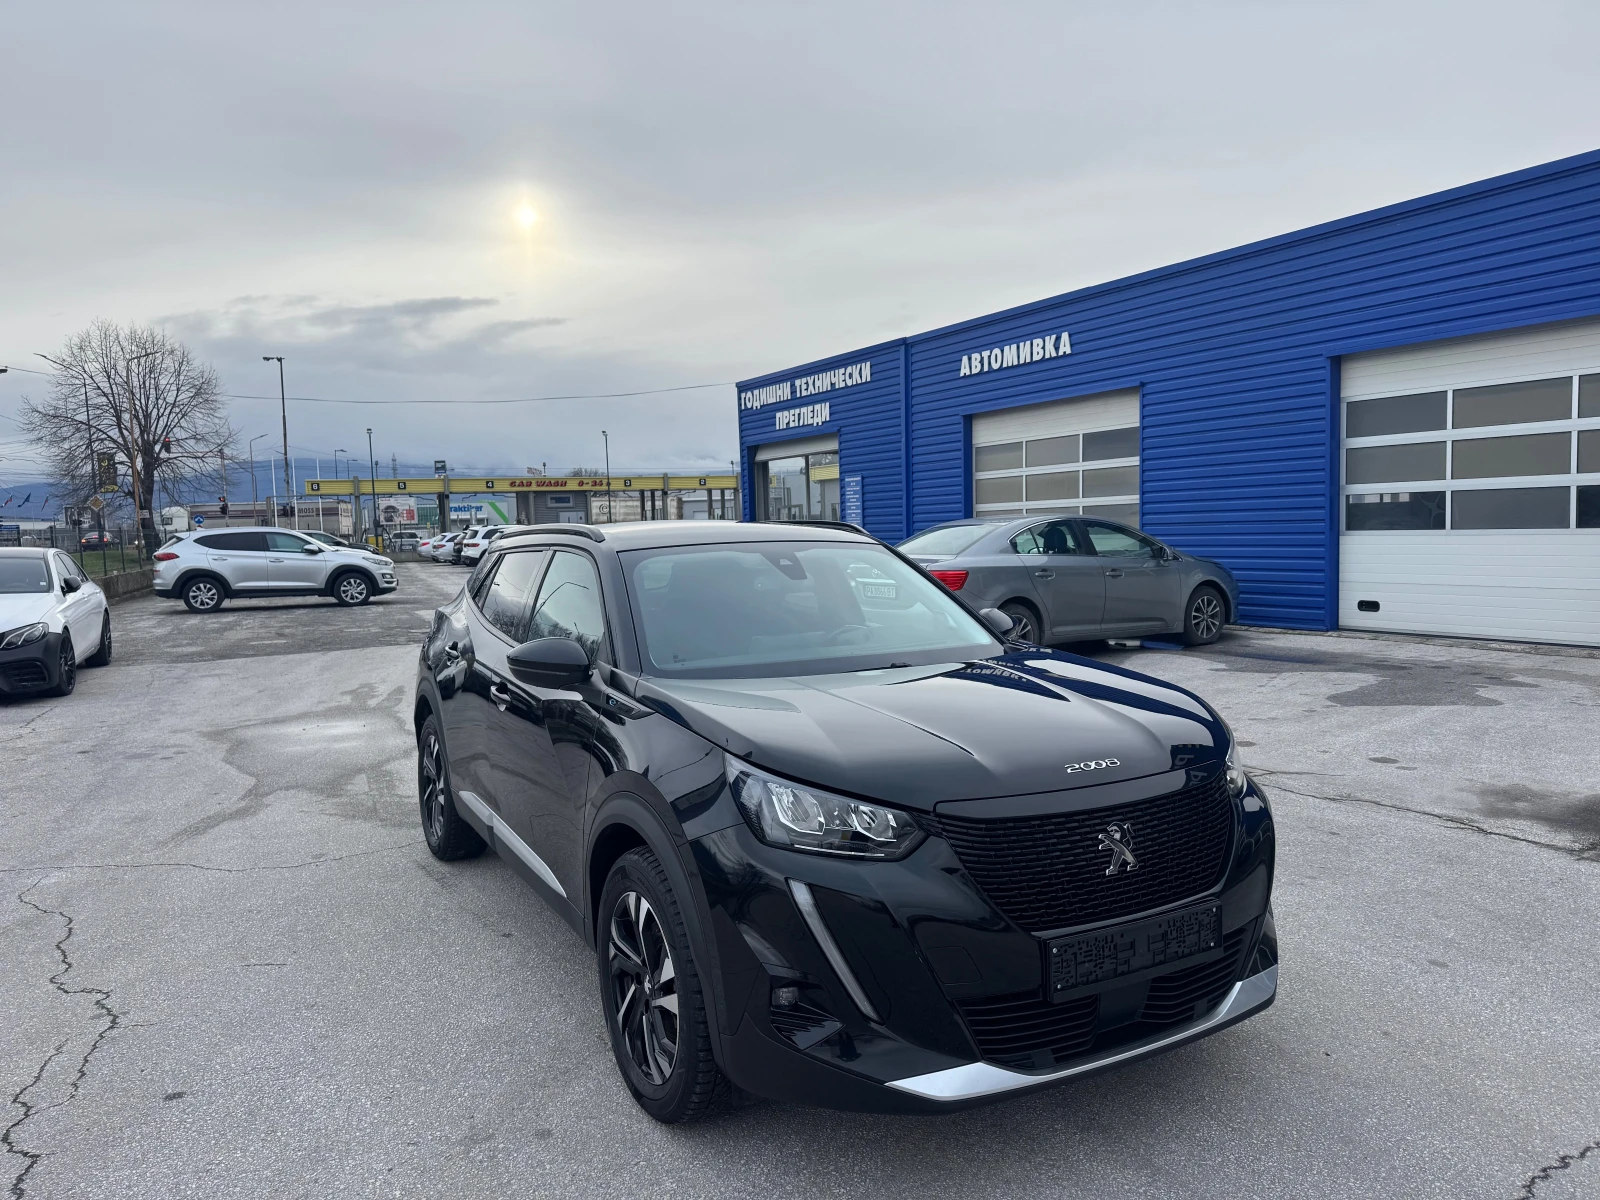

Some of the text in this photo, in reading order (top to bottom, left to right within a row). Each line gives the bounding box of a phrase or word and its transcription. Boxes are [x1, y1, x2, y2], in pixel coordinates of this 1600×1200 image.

[960, 331, 1072, 377] АВТОМИВКА
[741, 361, 871, 410] ГОДИШНИ ТЕХНИЧЕСКИ
[776, 402, 830, 430] ПРЕГЛЕДИ
[449, 504, 483, 512] raktiker
[1064, 758, 1120, 774] 2008
